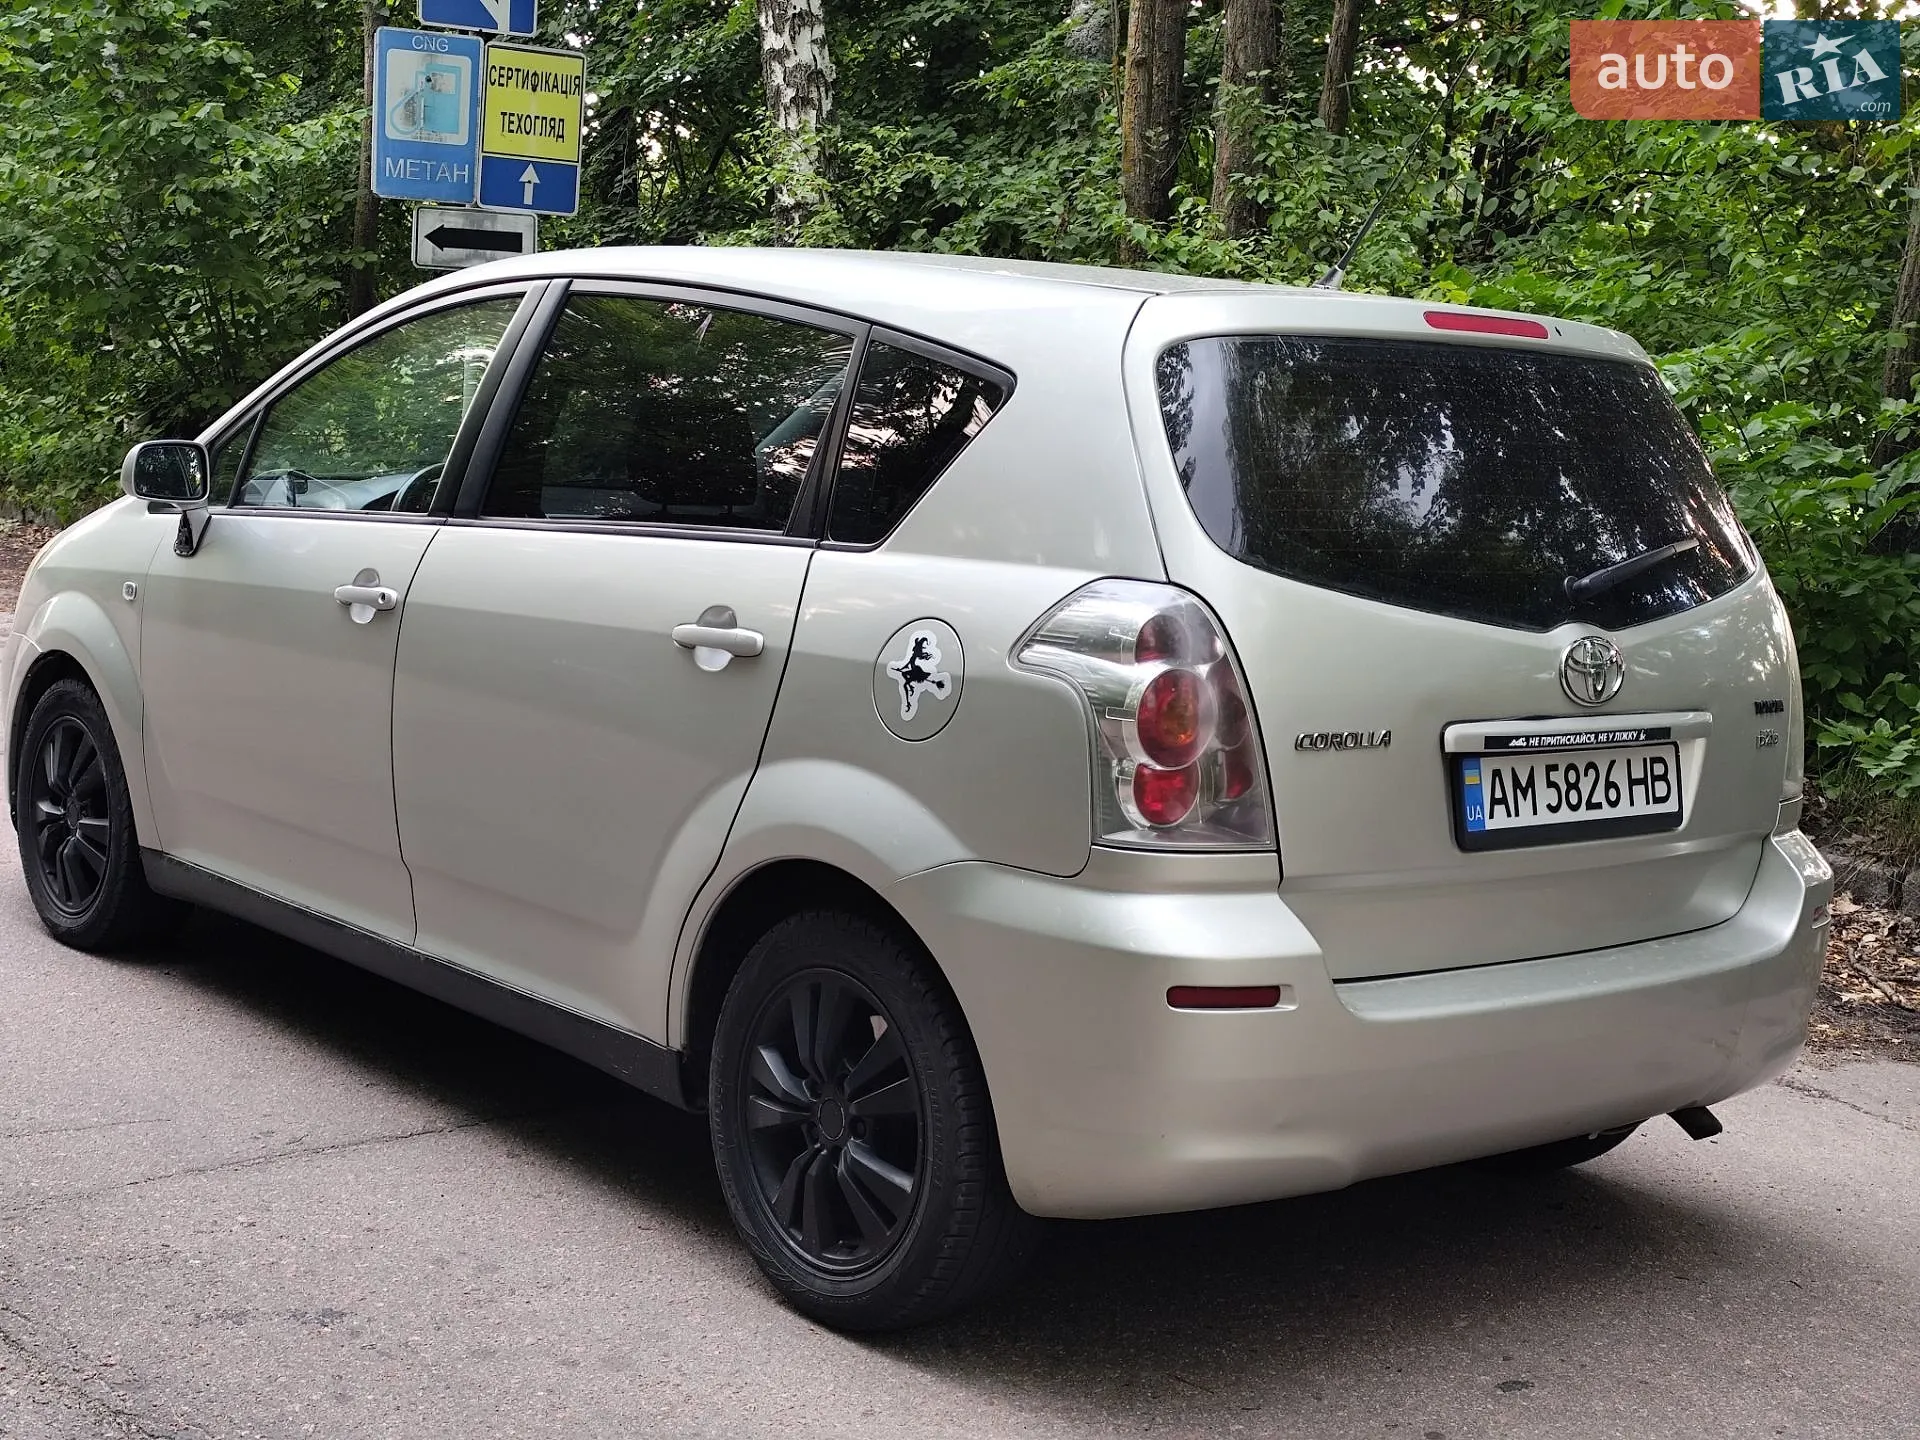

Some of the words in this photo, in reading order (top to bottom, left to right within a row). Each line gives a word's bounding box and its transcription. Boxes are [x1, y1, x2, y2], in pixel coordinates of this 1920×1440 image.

[411, 35, 449, 52] CNG
[488, 64, 581, 99] СЕРТИФІКАЦІЯ
[500, 111, 565, 143] ТЕХОГЛЯД
[385, 157, 469, 184] МЕТАН
[1294, 730, 1391, 751] COROLLA
[1528, 737, 1540, 746] НЕ
[1597, 732, 1608, 742] НЕ
[1489, 766, 1538, 819] AM
[1545, 760, 1621, 813] 5826
[1627, 757, 1671, 807] HB
[1467, 807, 1483, 821] UA
